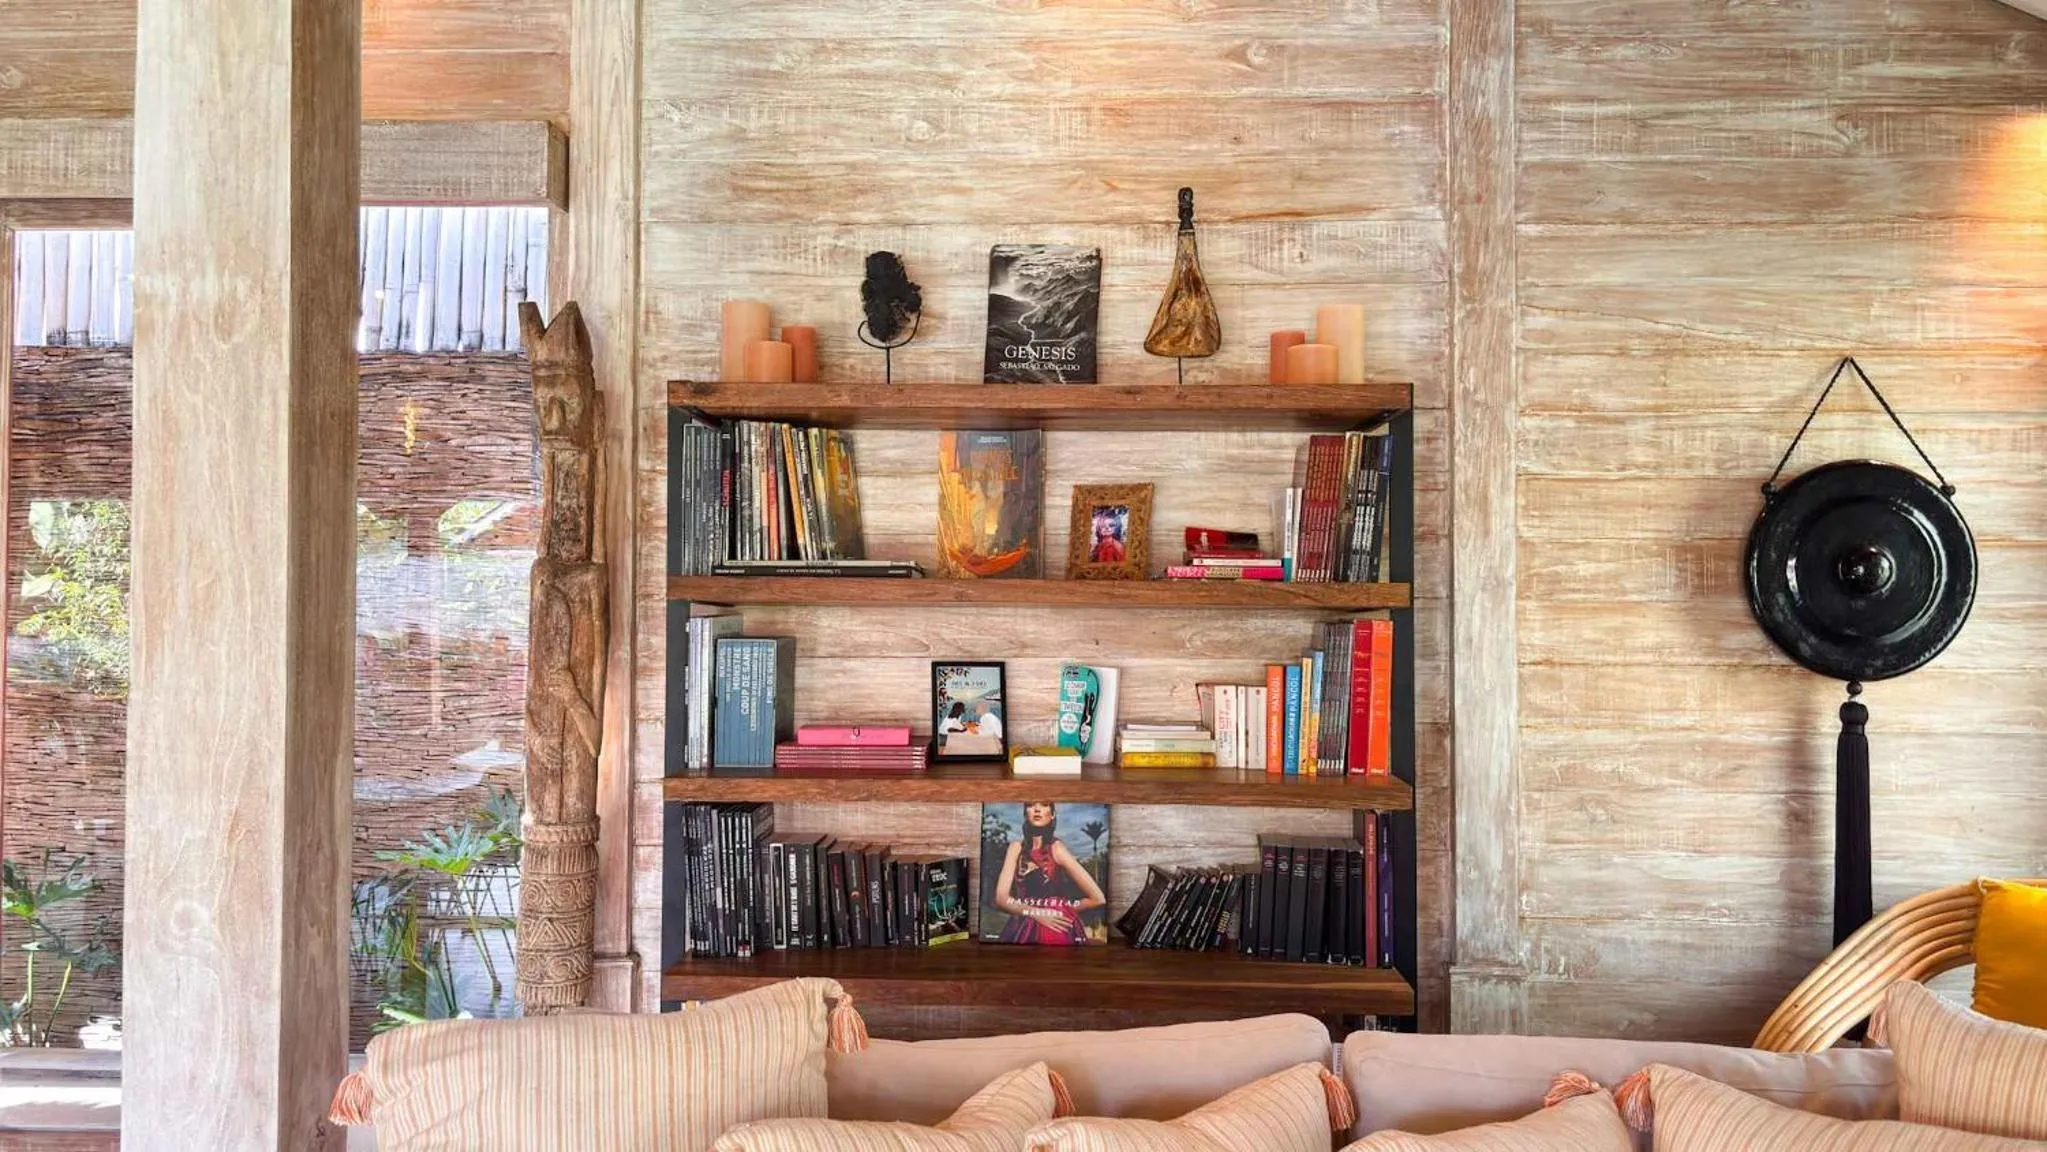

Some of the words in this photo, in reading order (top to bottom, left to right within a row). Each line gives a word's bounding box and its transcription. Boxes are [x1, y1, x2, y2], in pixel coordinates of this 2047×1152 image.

[1004, 344, 1077, 360] GENESIS
[742, 647, 751, 673] SANG
[742, 674, 750, 688] DE
[1290, 675, 1298, 712] PANCOL
[741, 689, 750, 715] COUP
[1006, 896, 1081, 907] HASSELBLAD
[1022, 909, 1064, 917] MASTERS
